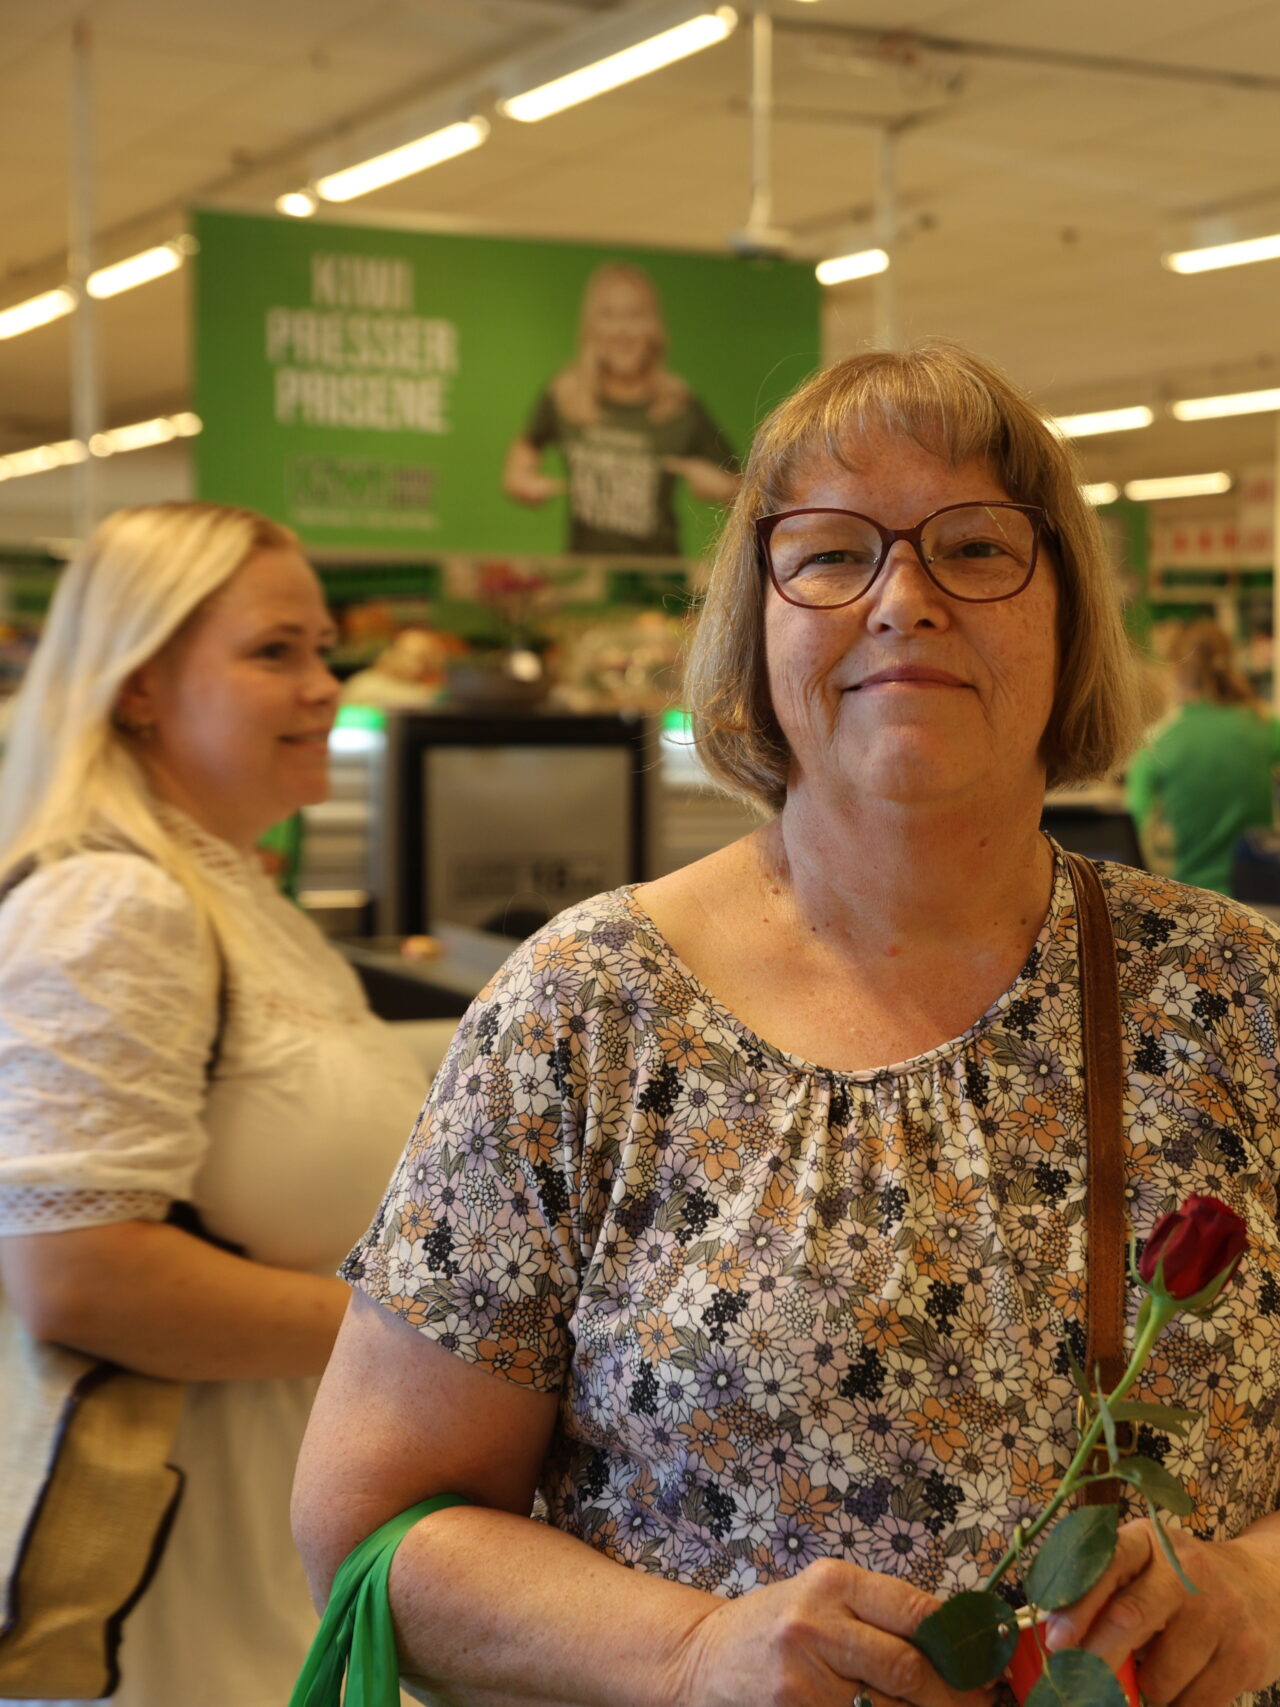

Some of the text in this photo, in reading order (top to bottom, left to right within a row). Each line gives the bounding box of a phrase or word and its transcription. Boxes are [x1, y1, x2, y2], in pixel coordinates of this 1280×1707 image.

[311, 252, 415, 310] KIWI
[265, 307, 459, 374] PRESSER
[275, 368, 452, 435] PRISENE
